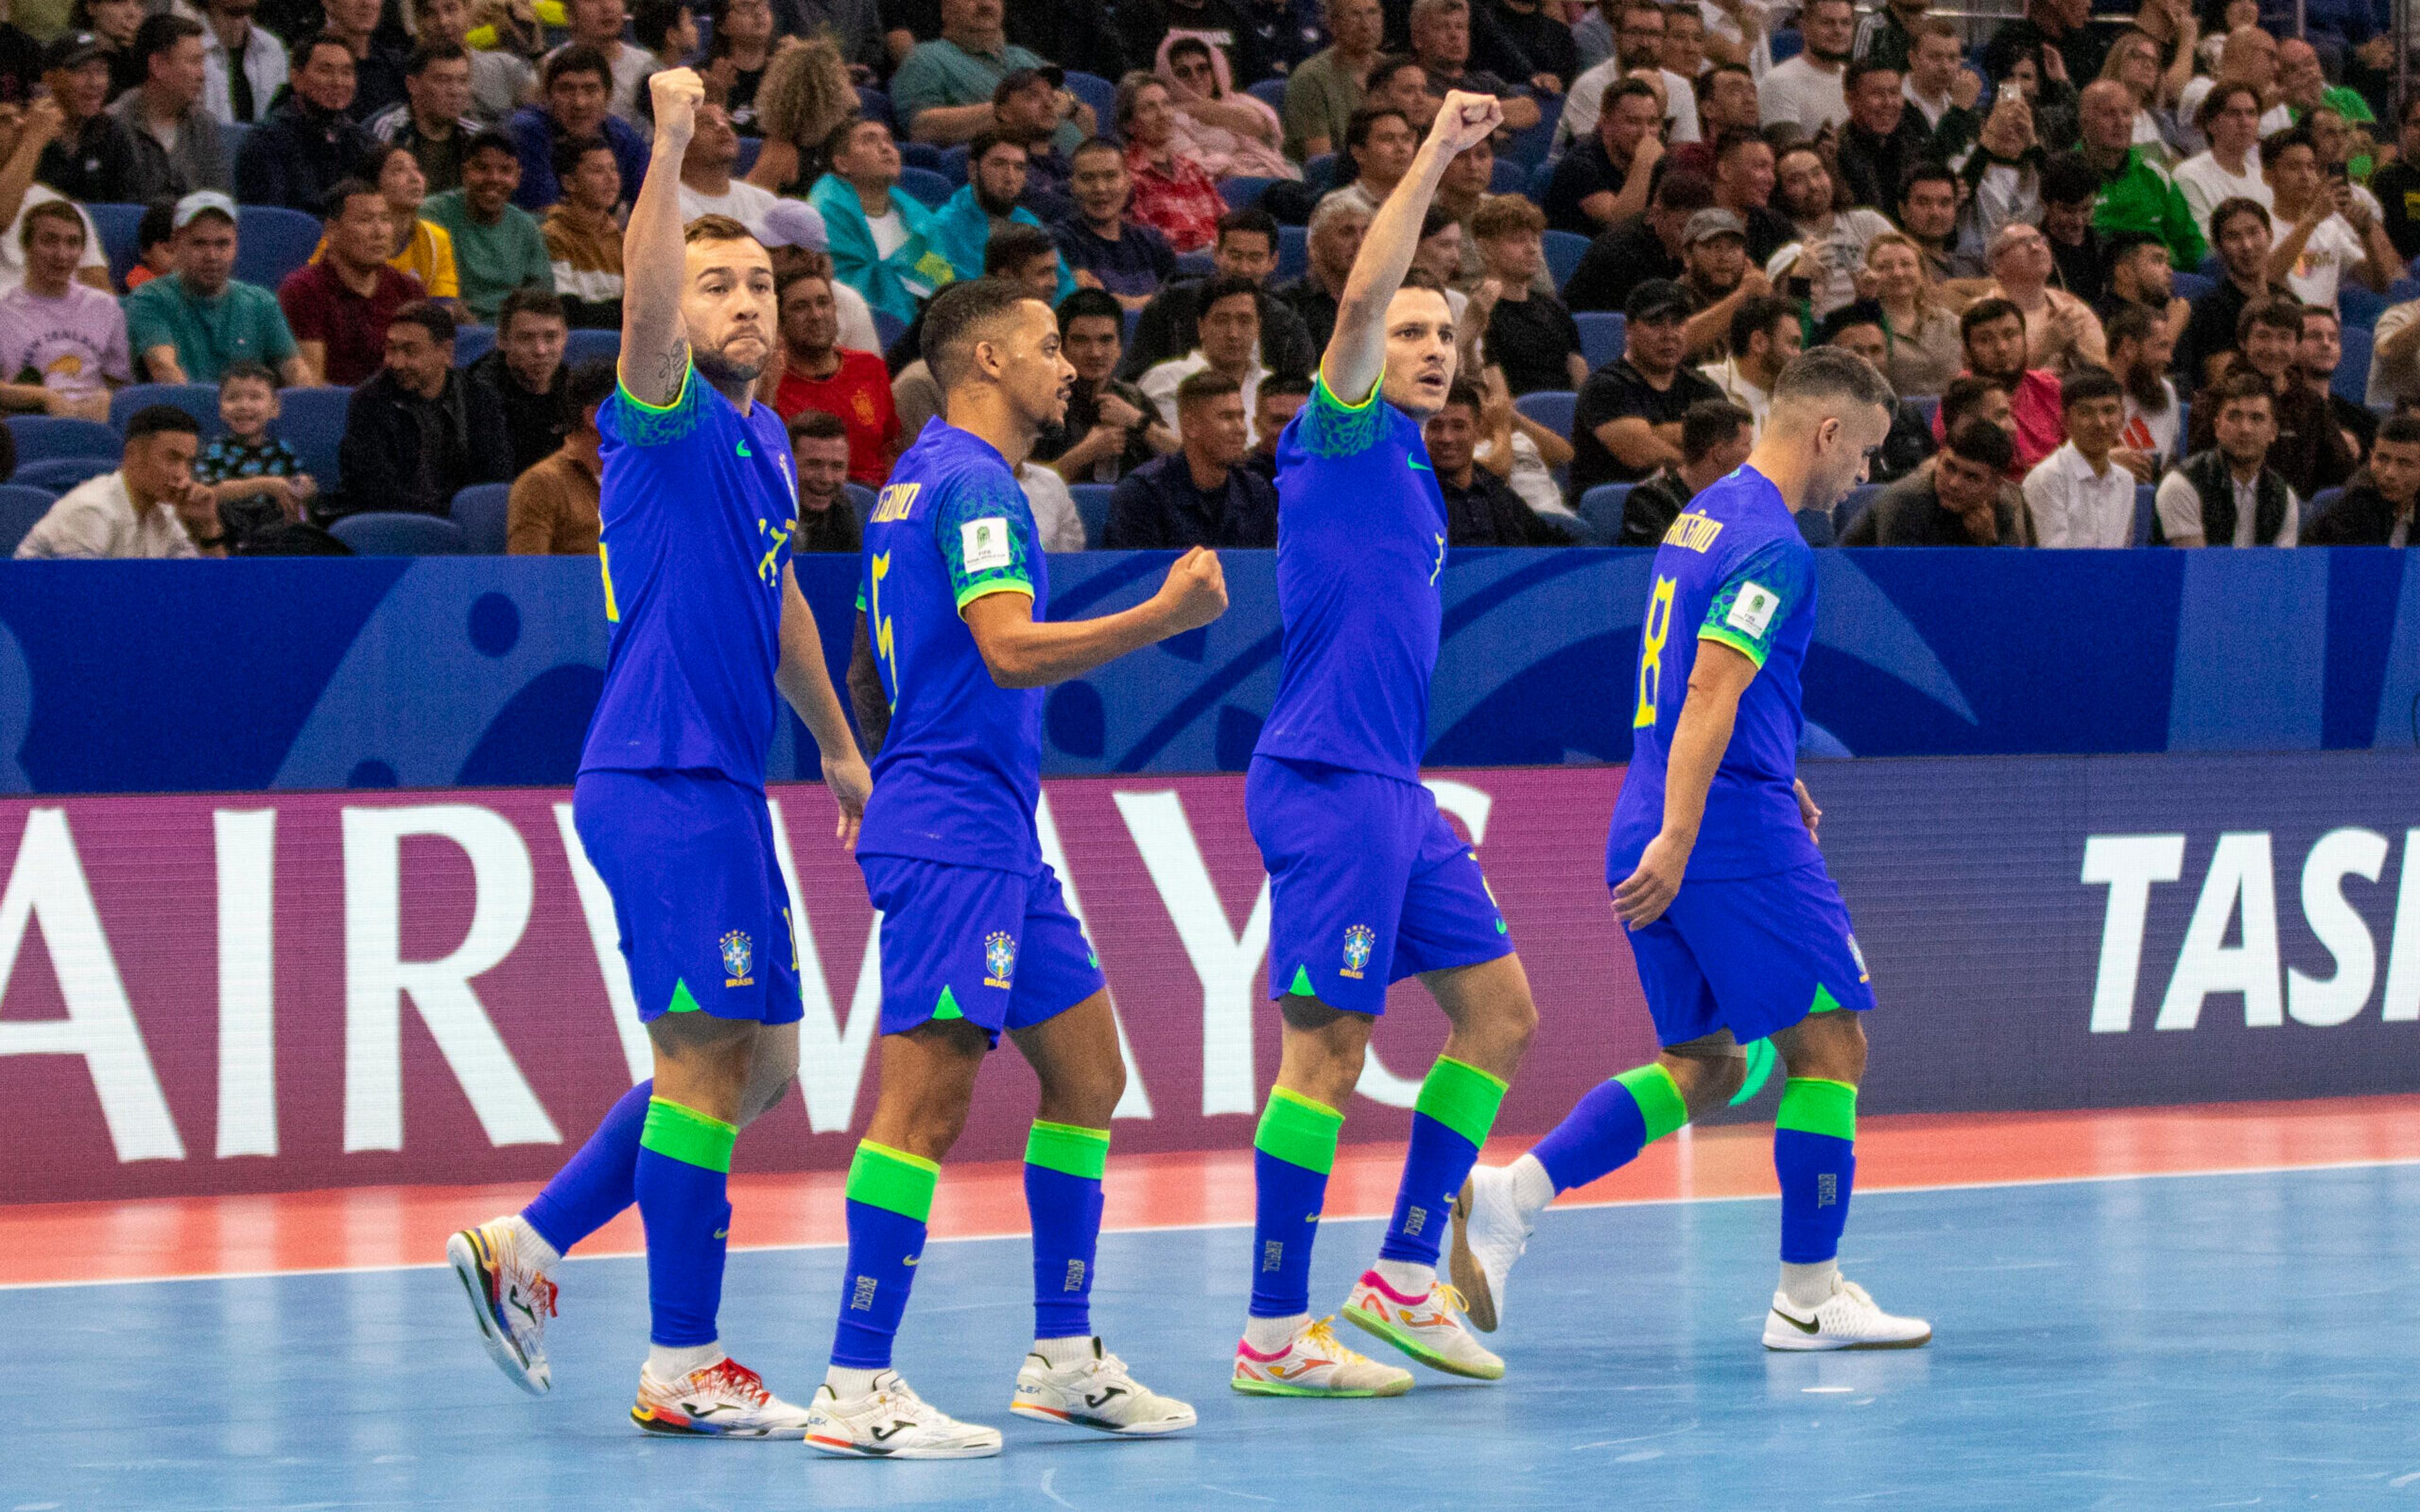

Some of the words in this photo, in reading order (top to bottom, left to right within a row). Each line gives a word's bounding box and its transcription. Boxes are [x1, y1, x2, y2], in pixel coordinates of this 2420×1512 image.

[1634, 574, 1677, 728] 8
[983, 977, 1011, 990] BRASI
[850, 1274, 879, 1312] BRASIL
[1063, 1259, 1085, 1292] BRASIL
